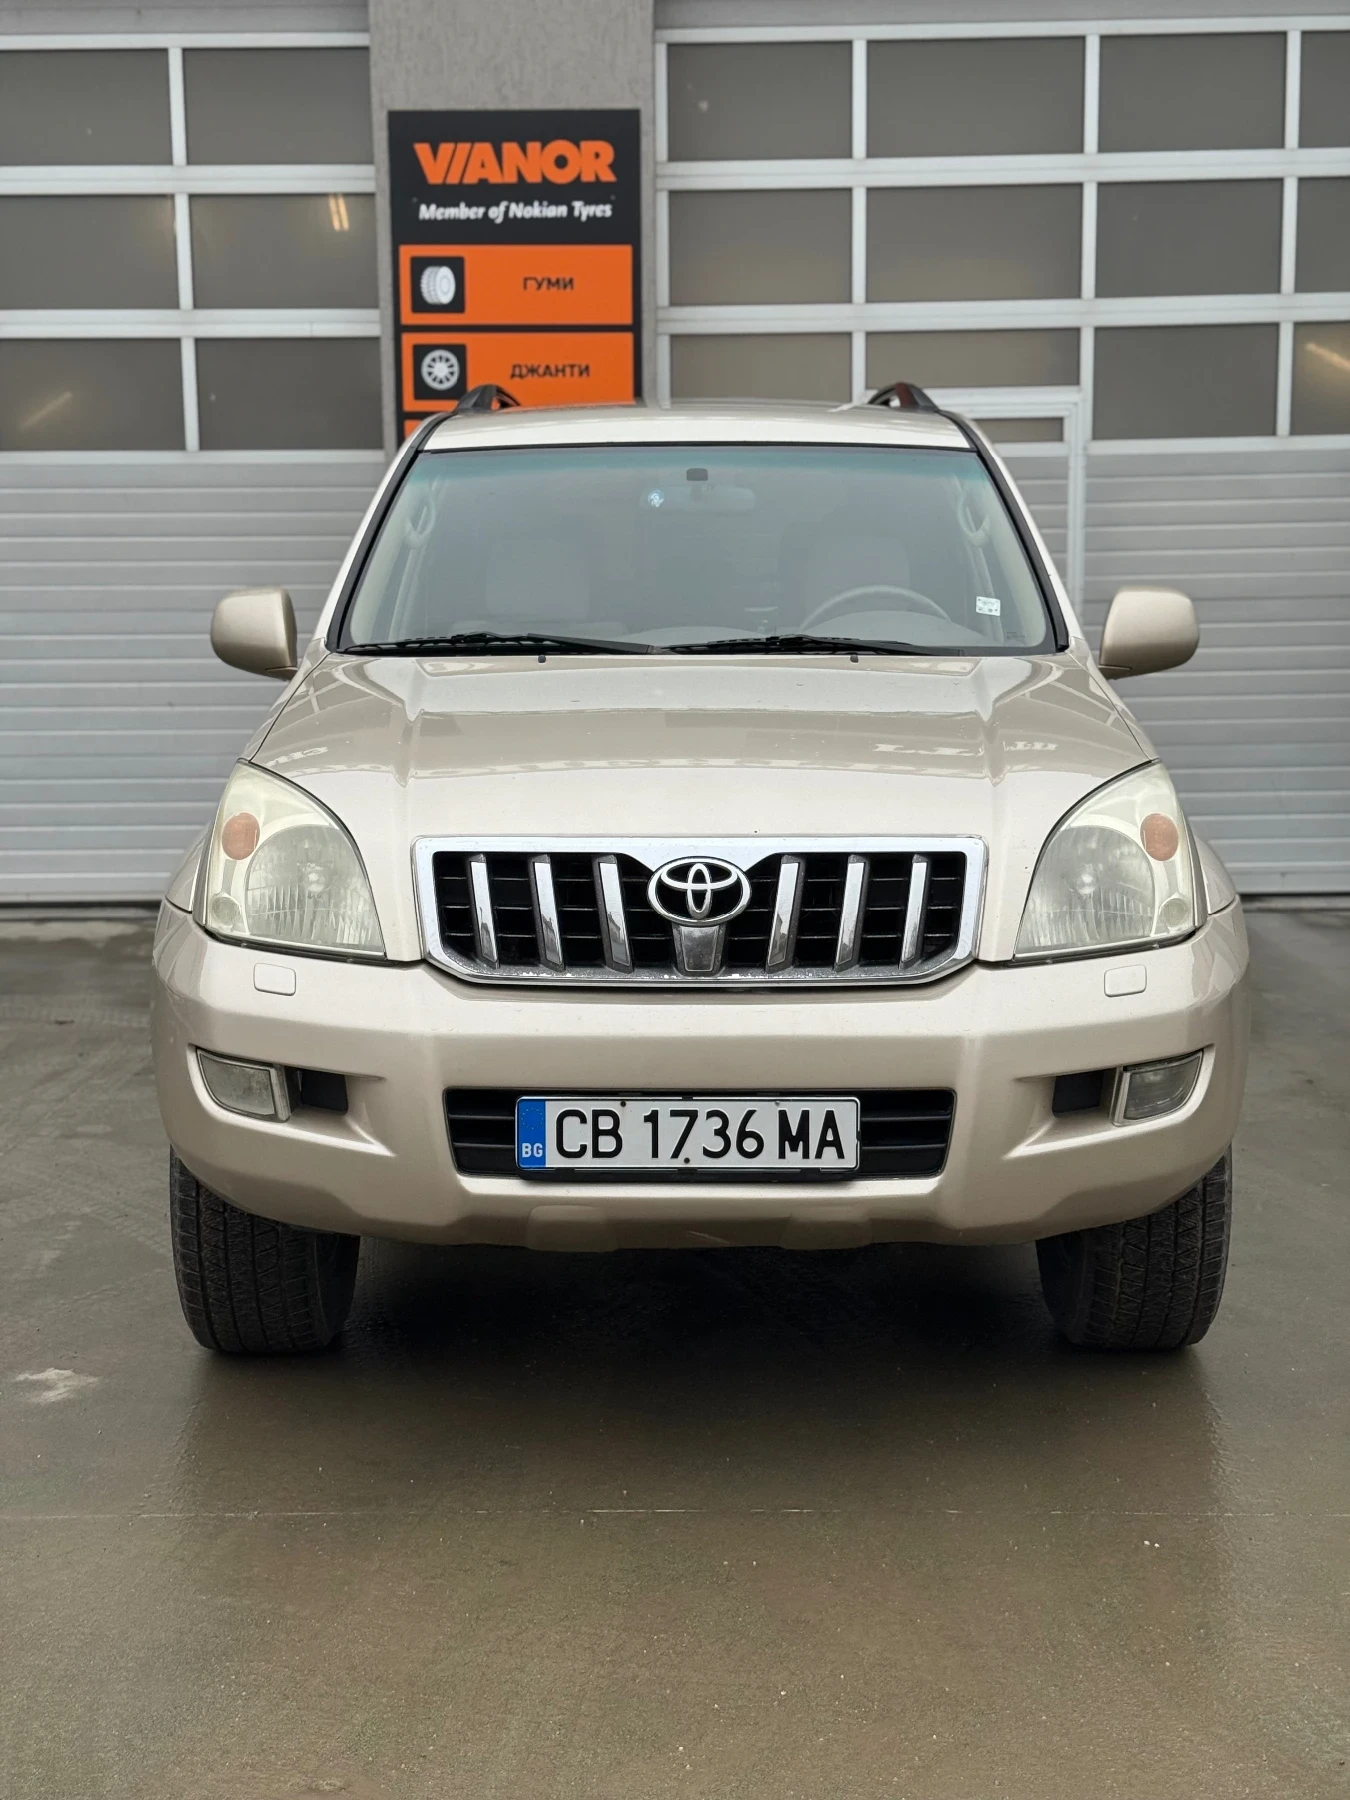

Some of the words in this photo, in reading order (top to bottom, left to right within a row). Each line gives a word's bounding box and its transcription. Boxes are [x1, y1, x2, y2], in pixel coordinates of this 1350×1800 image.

[413, 139, 617, 185] VIANOR
[418, 202, 486, 221] Member
[488, 201, 508, 224] of
[508, 201, 568, 219] Nokian
[572, 200, 613, 222] Tyres
[522, 276, 574, 292] ГУМИ
[510, 363, 591, 380] ДЖАНТИ
[555, 1109, 623, 1160] CB
[643, 1109, 765, 1160] 1736
[777, 1109, 845, 1160] MA
[521, 1142, 544, 1159] BG
